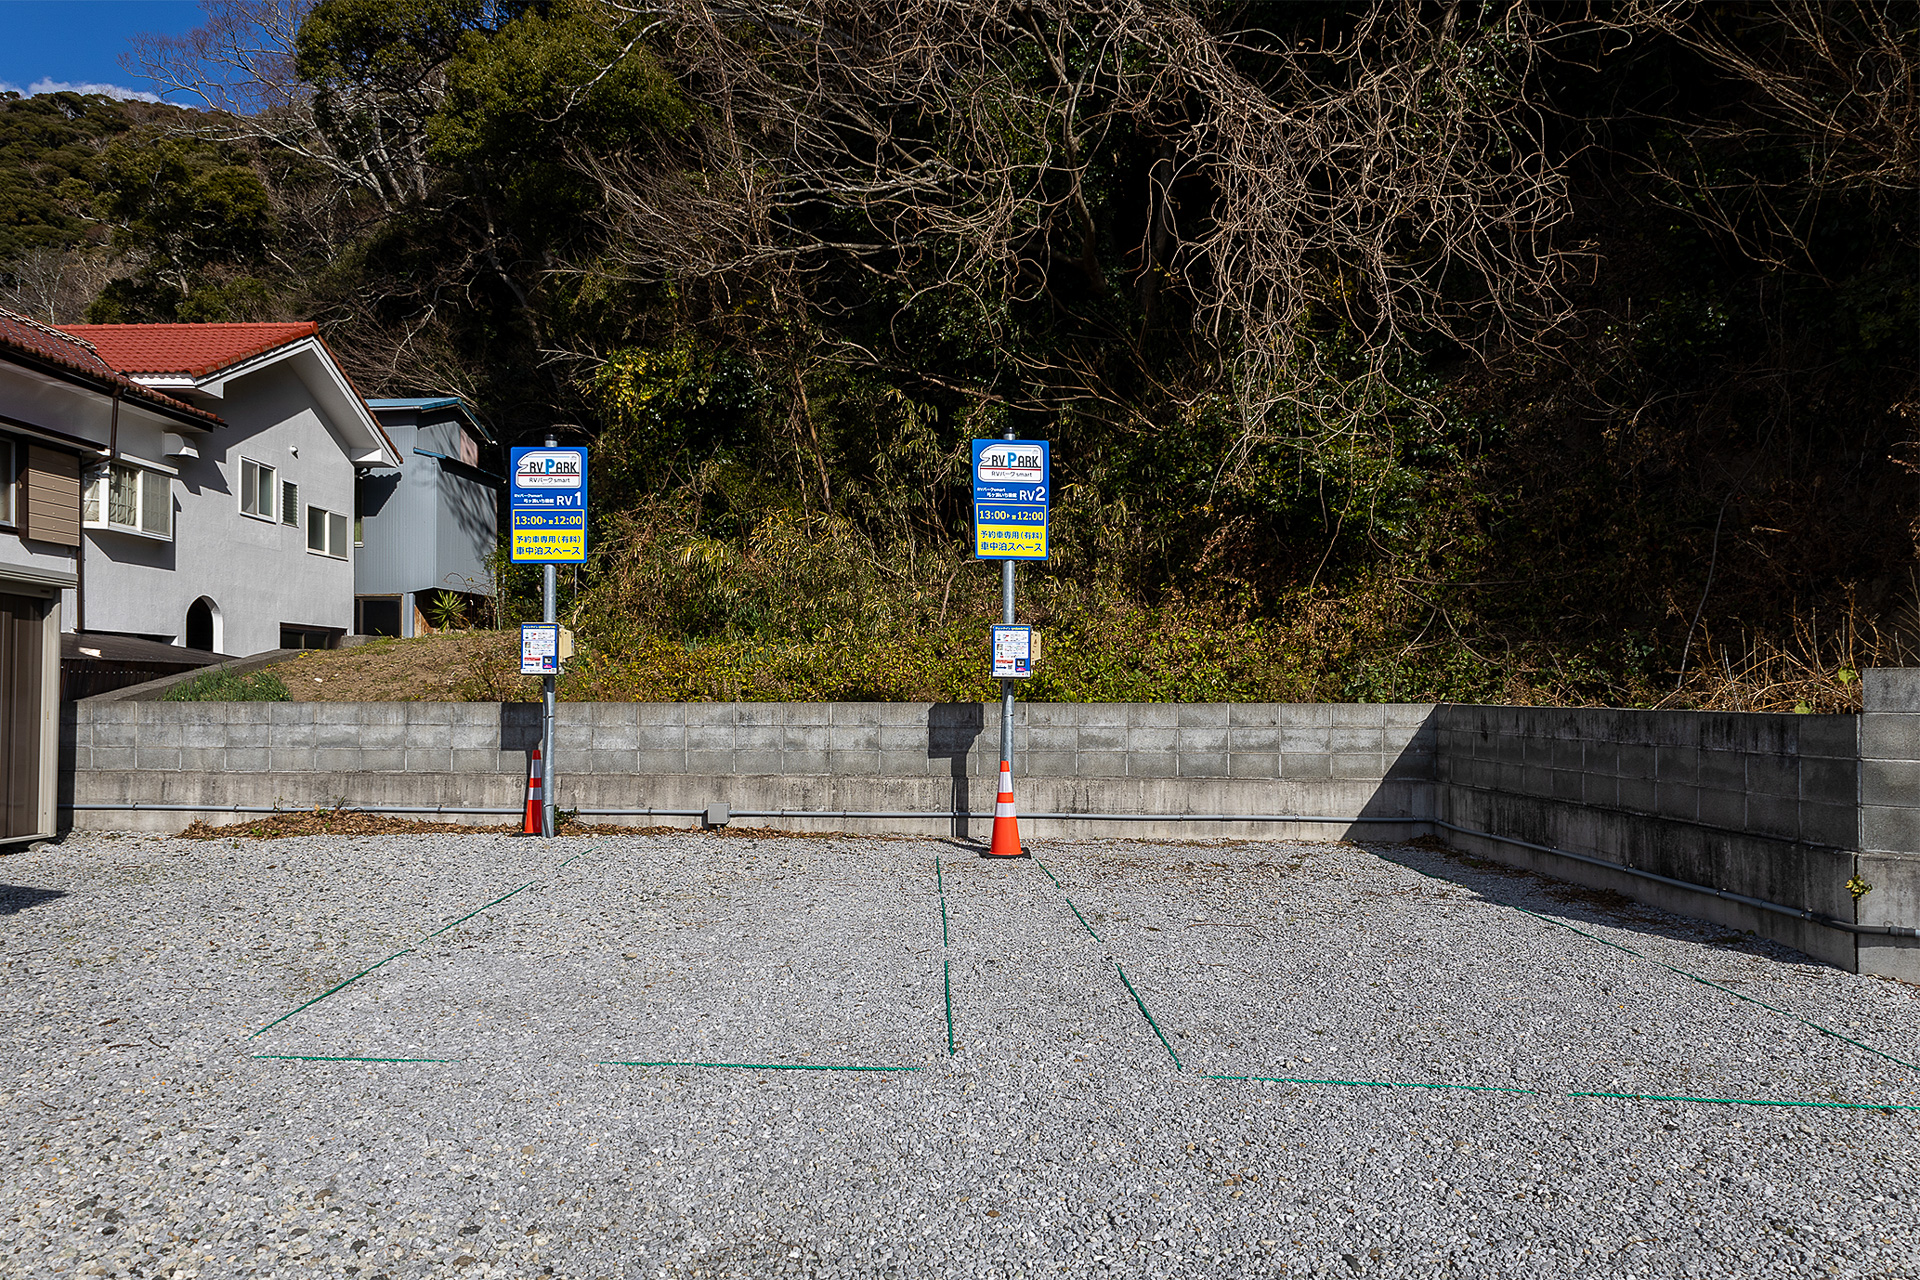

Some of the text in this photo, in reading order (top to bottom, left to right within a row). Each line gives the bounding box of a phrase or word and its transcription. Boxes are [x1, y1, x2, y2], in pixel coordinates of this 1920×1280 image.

[530, 458, 576, 475] RV PARK
[991, 452, 1039, 468] RV PARK
[516, 546, 581, 555] 車中泊スペース
[981, 542, 1043, 552] 車中泊スペース
